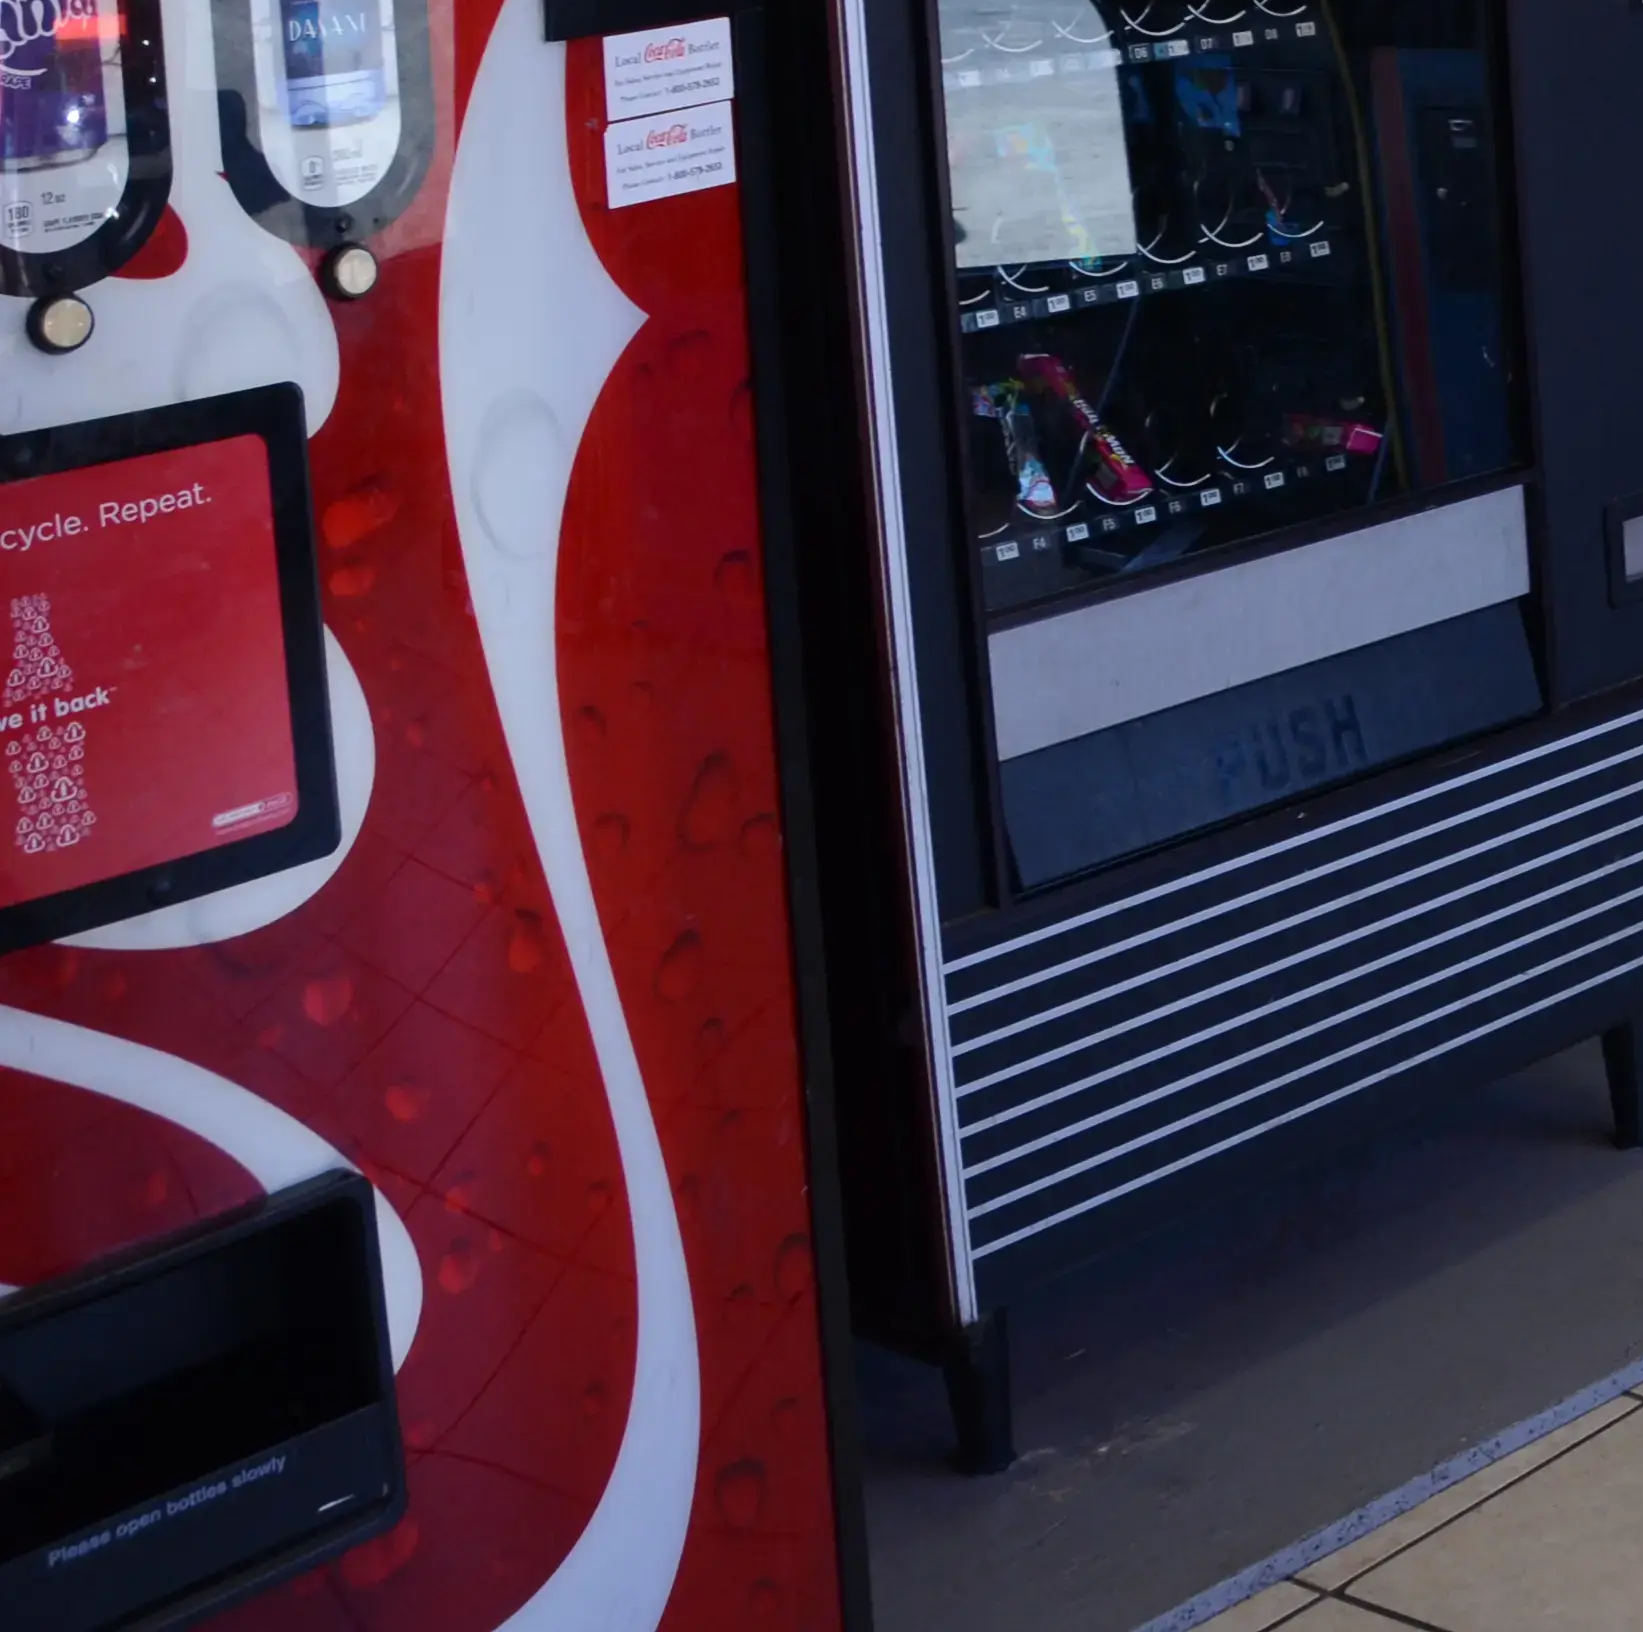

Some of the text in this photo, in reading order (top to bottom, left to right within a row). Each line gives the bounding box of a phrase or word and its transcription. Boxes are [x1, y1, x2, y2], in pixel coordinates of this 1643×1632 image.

[615, 52, 641, 68] Local
[617, 140, 643, 155] Local
[41, 191, 53, 206] 12
[98, 482, 212, 528] Repeat.
[30, 703, 48, 723] it
[54, 687, 110, 717] back
[1215, 694, 1368, 806] PUSH
[48, 1455, 286, 1567] Please open bottles slowly
